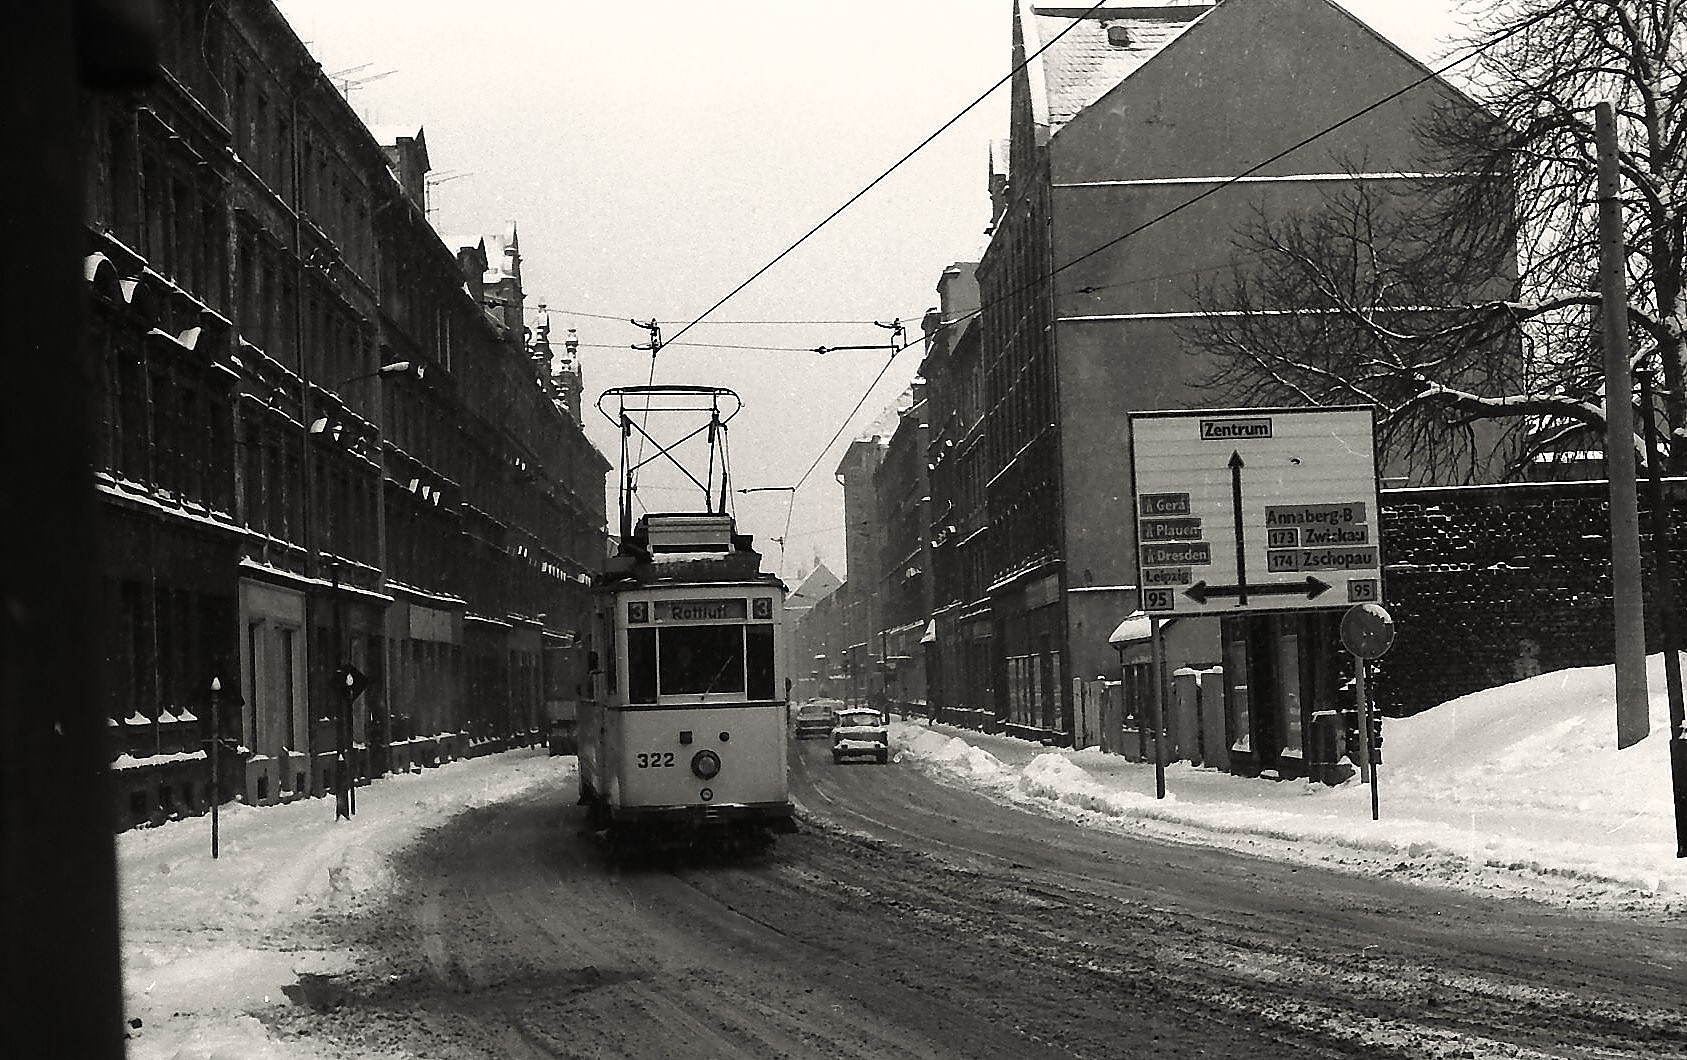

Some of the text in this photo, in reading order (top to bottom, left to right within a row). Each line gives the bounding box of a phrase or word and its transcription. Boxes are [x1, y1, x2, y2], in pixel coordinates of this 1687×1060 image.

[1204, 422, 1269, 438] Zentrum
[1156, 498, 1186, 511] Gera
[1267, 507, 1353, 525] Annaberg-B
[1156, 525, 1198, 537] Plauen
[1272, 529, 1365, 544] 173 Zwickau
[1157, 549, 1207, 561] Dresden
[1272, 551, 1372, 569] 174 Zschopau
[1146, 570, 1189, 585] Leipzig
[1354, 583, 1370, 597] 95
[1148, 592, 1167, 607] 95
[630, 603, 646, 620] 3
[757, 599, 770, 617] 3
[637, 752, 675, 769] 322
